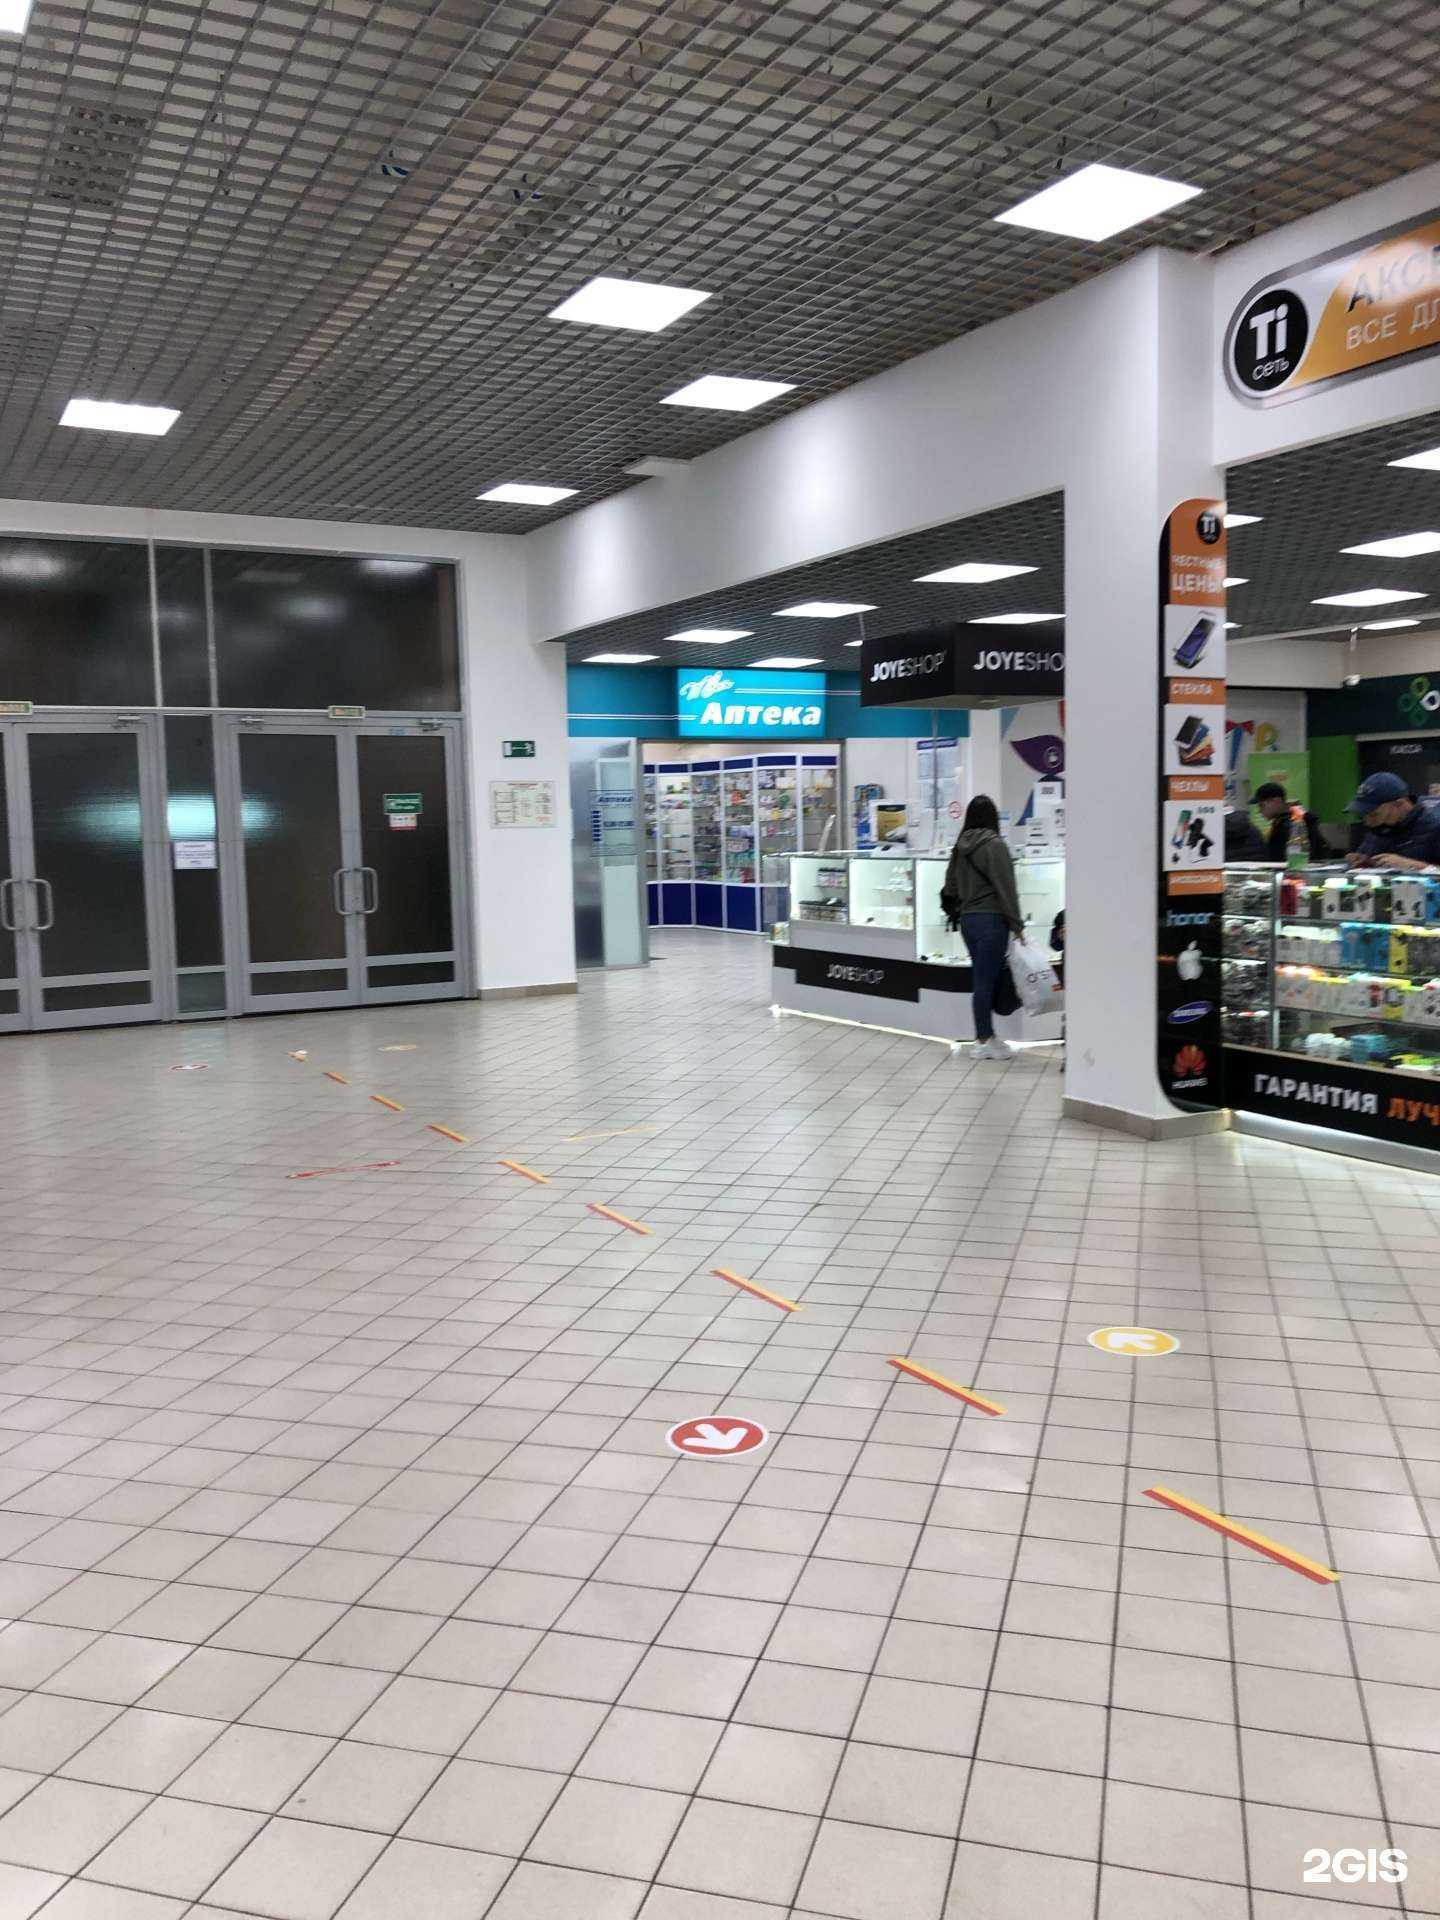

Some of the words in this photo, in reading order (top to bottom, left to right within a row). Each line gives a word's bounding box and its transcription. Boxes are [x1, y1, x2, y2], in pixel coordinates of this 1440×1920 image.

[1250, 303, 1289, 360] Ti
[1346, 312, 1398, 351] ВСЕ
[1171, 573, 1223, 595] ЦЕНЫ
[870, 651, 945, 682] JOYESHOP
[700, 702, 821, 726] Аптека
[1167, 912, 1214, 927] honor
[826, 963, 885, 985] JOYESHOP
[1254, 1073, 1379, 1115] ГАРАНТИЯ
